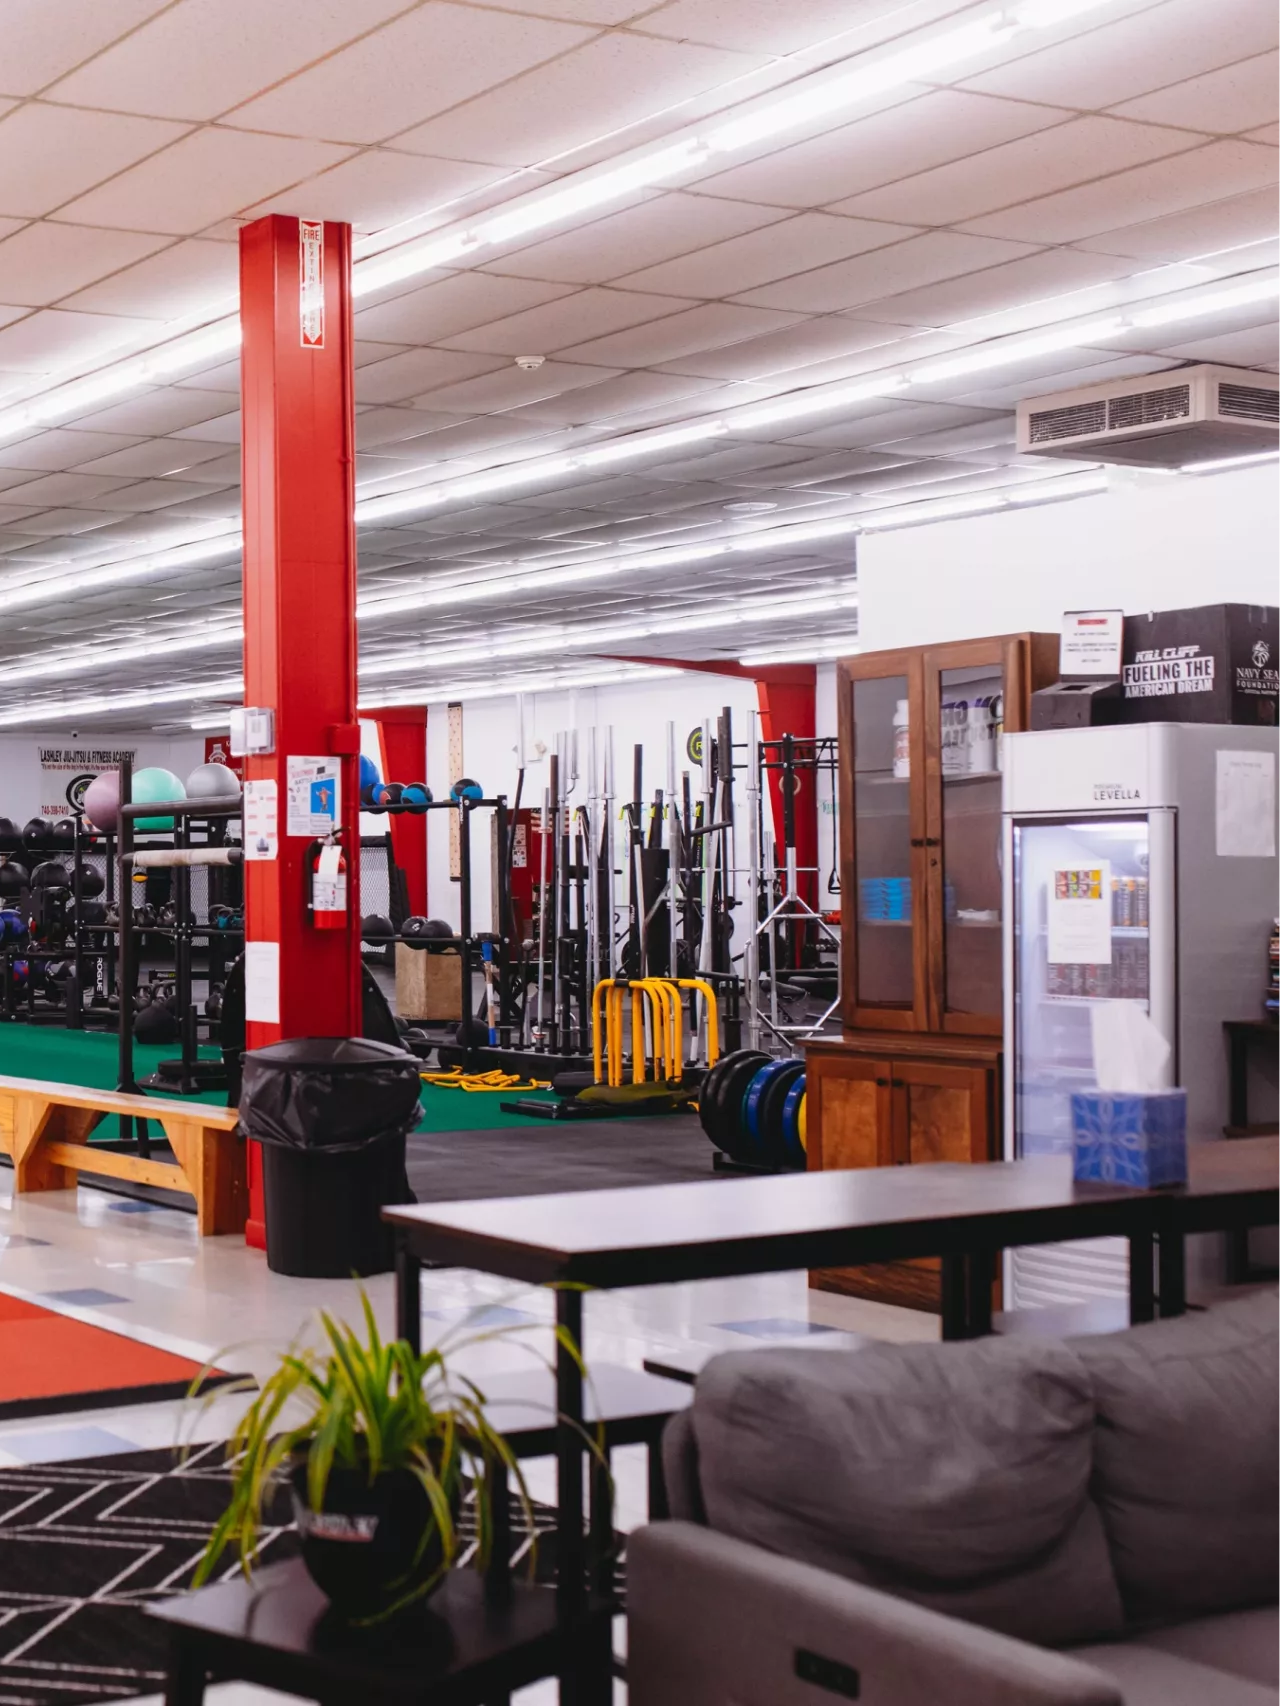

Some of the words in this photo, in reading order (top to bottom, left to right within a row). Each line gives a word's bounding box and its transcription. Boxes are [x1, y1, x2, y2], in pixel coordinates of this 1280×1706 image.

[304, 228, 319, 240] FIRE
[1135, 649, 1162, 663] KILL
[1162, 645, 1201, 659] CLIFF
[1125, 662, 1180, 683] FUELING
[1186, 659, 1211, 678] THE
[1236, 667, 1260, 679] NAVY
[1263, 669, 1280, 680] SEA
[1124, 682, 1176, 698] AMERICAN
[1177, 678, 1213, 694] DREAM
[1236, 680, 1280, 690] FOUNDATIO
[40, 750, 62, 762] LASHLEY
[63, 750, 87, 763] JIU-JITSU
[92, 751, 112, 763] FITNESS
[113, 751, 135, 764] ACADEMY
[1093, 789, 1141, 801] LEVELLA
